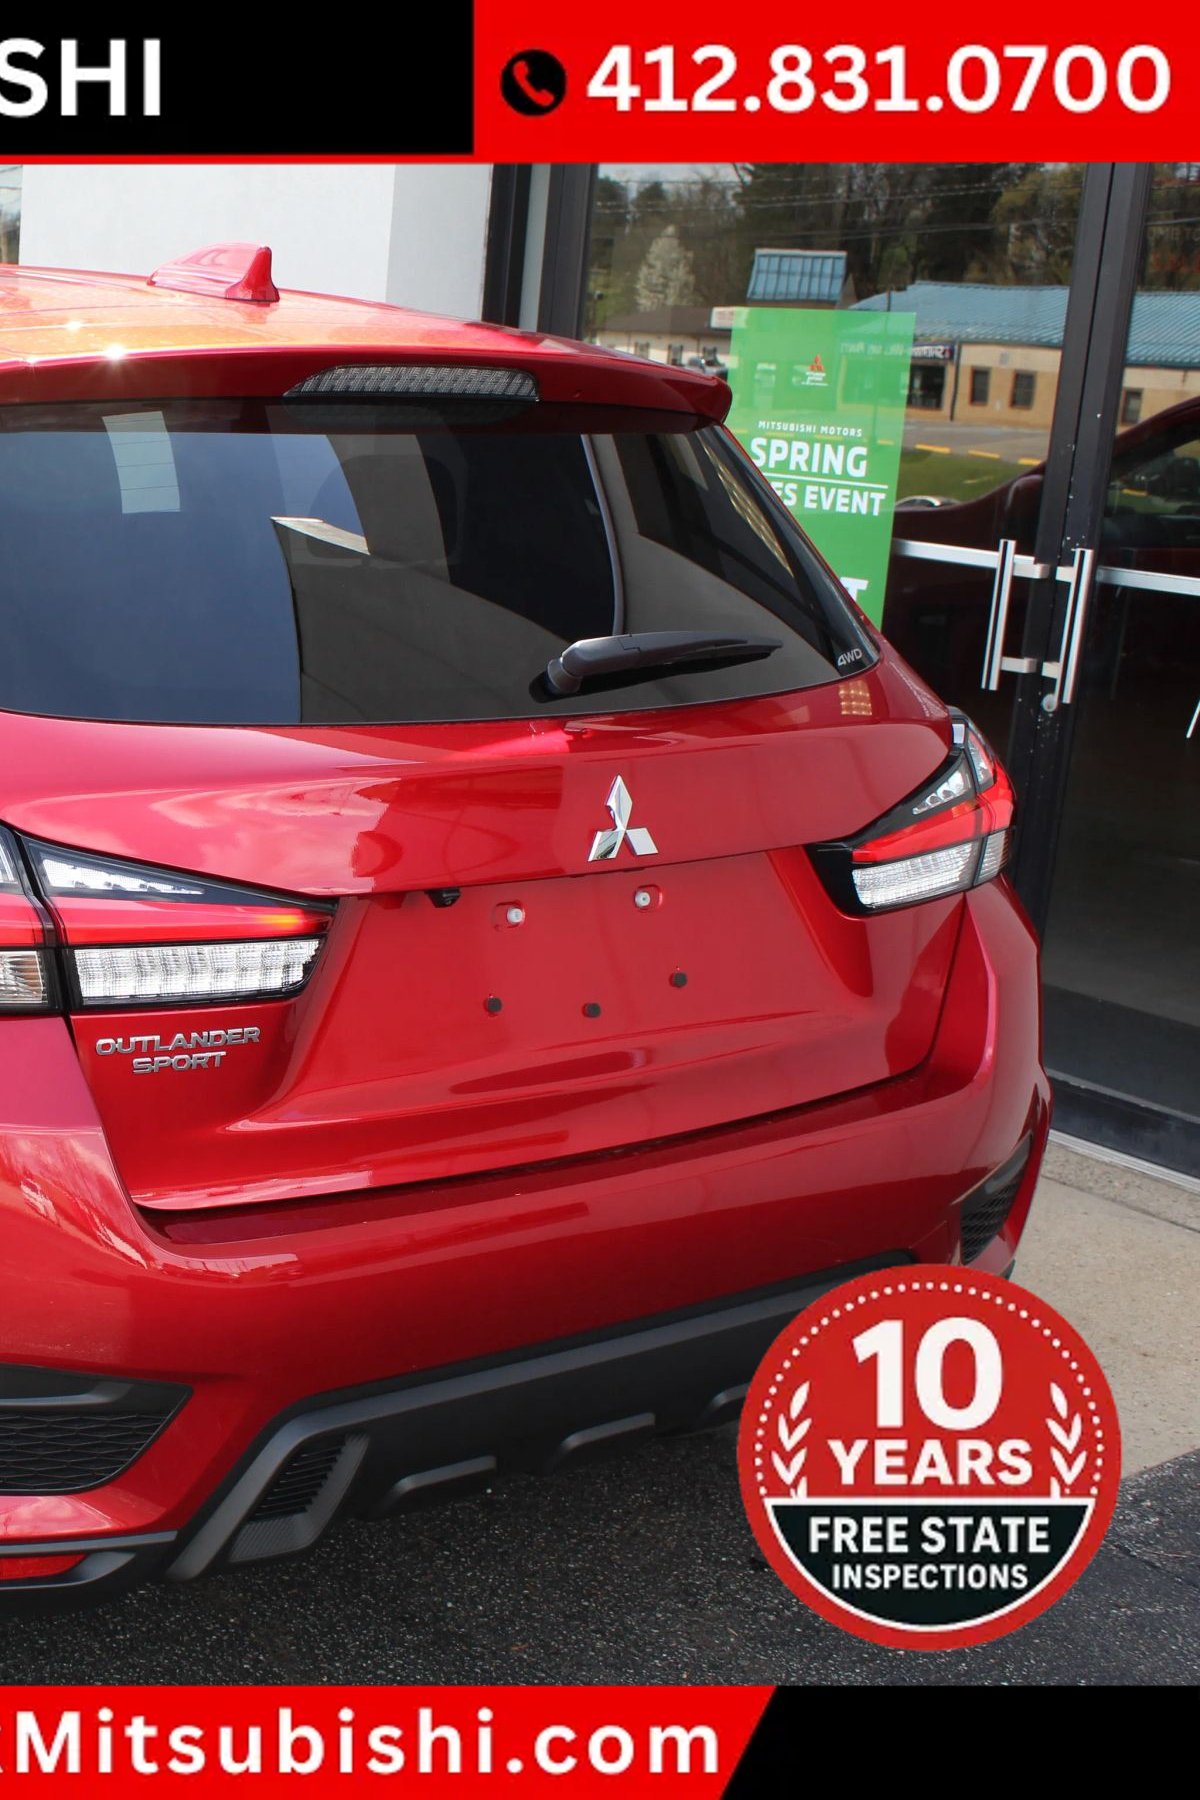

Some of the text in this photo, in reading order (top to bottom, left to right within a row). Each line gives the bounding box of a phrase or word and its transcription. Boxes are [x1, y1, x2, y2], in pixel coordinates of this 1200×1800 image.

[758, 420, 863, 438] MITSUBISHI MOTORS
[750, 437, 868, 477] SPRING
[804, 485, 886, 516] EVENT
[837, 648, 863, 667] 4WD
[96, 1026, 261, 1055] OUTLANDER
[132, 1051, 227, 1074] SPORT
